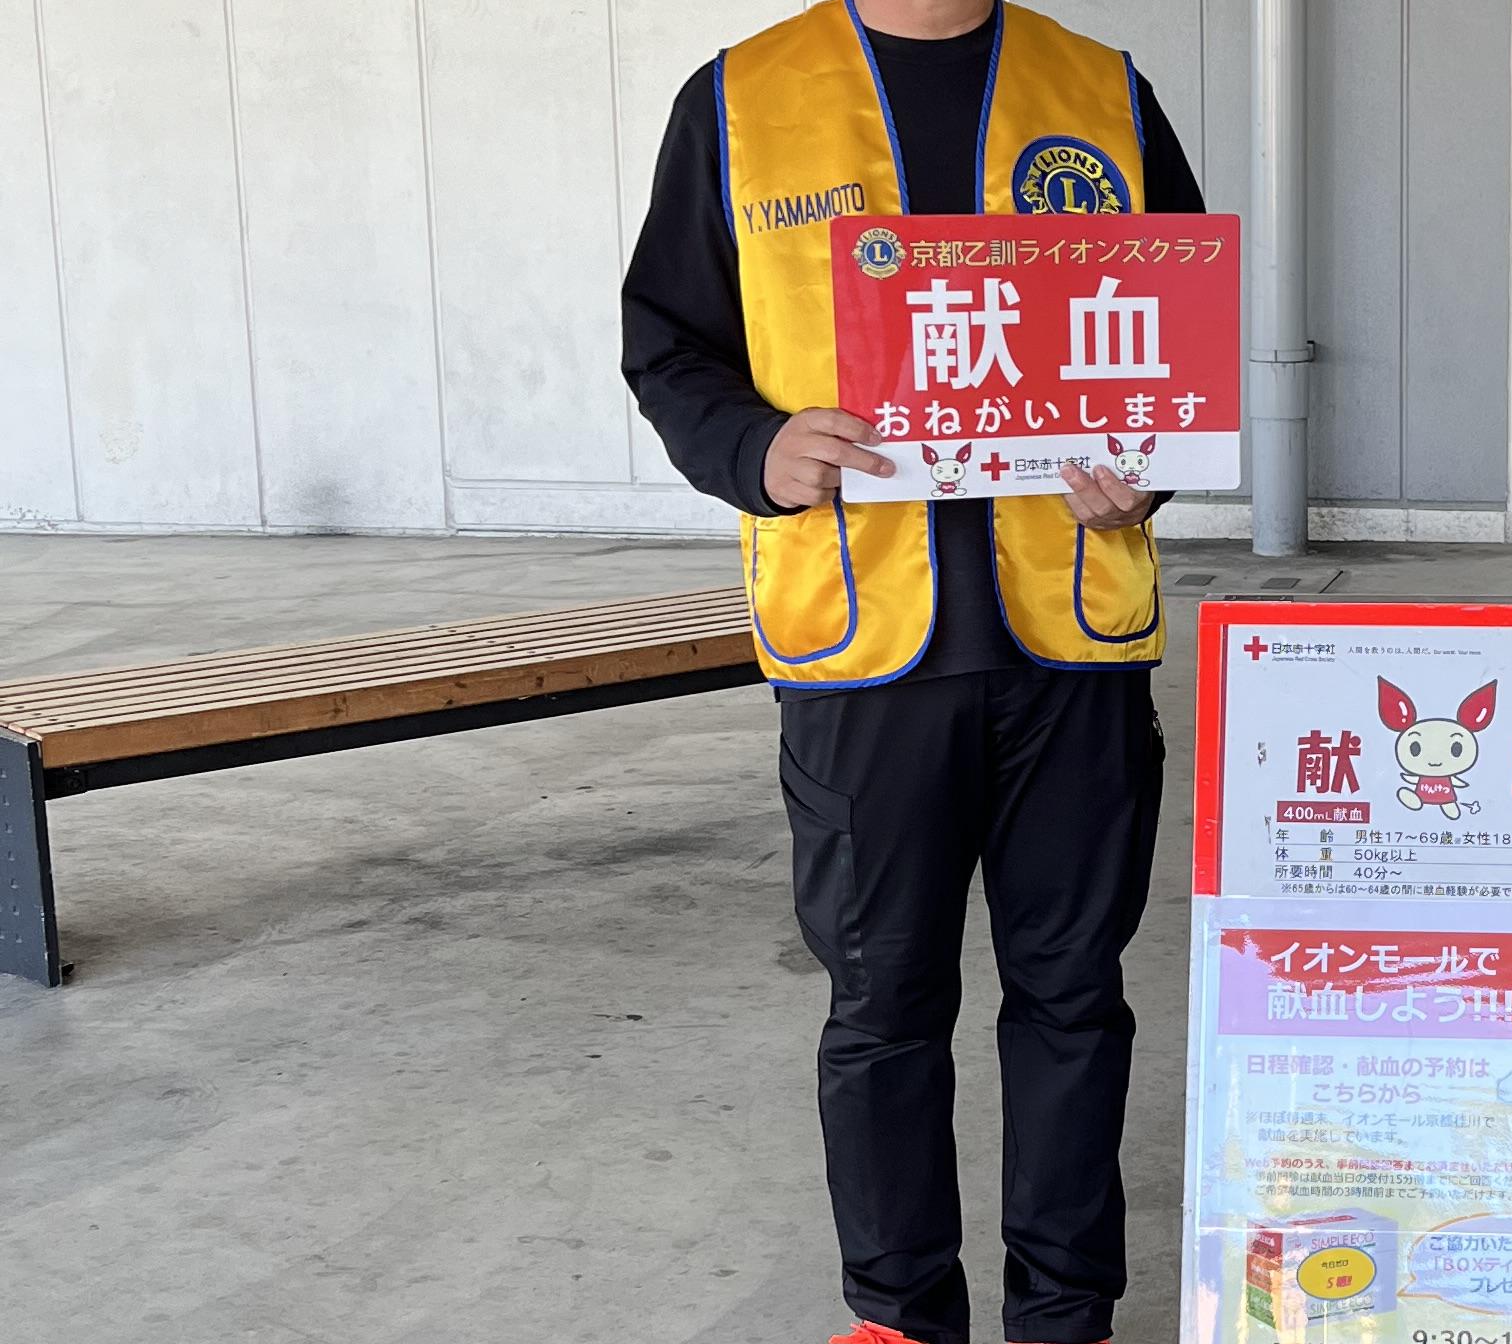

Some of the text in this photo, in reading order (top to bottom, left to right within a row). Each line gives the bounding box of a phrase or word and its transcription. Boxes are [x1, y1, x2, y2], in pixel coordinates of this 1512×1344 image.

[1040, 149, 1100, 176] LIONS
[1060, 177, 1088, 214] L
[742, 182, 865, 234] Y.YAMAMOTO
[873, 243, 889, 262] L
[909, 235, 1225, 268] 京都乙訓ライオンズクラブ
[874, 392, 1207, 438] おねがいします
[1272, 643, 1335, 655] 日本赤十字社
[1420, 783, 1451, 795] けんけつ
[1283, 807, 1363, 822] 400mL献血
[1354, 848, 1418, 863] 50kg以上
[1274, 865, 1403, 879] 所要時間 40分～
[1270, 942, 1500, 976] イオンモールで
[1247, 1054, 1490, 1079] 日程確認・献血の予約は
[1312, 1082, 1422, 1104] こちらから
